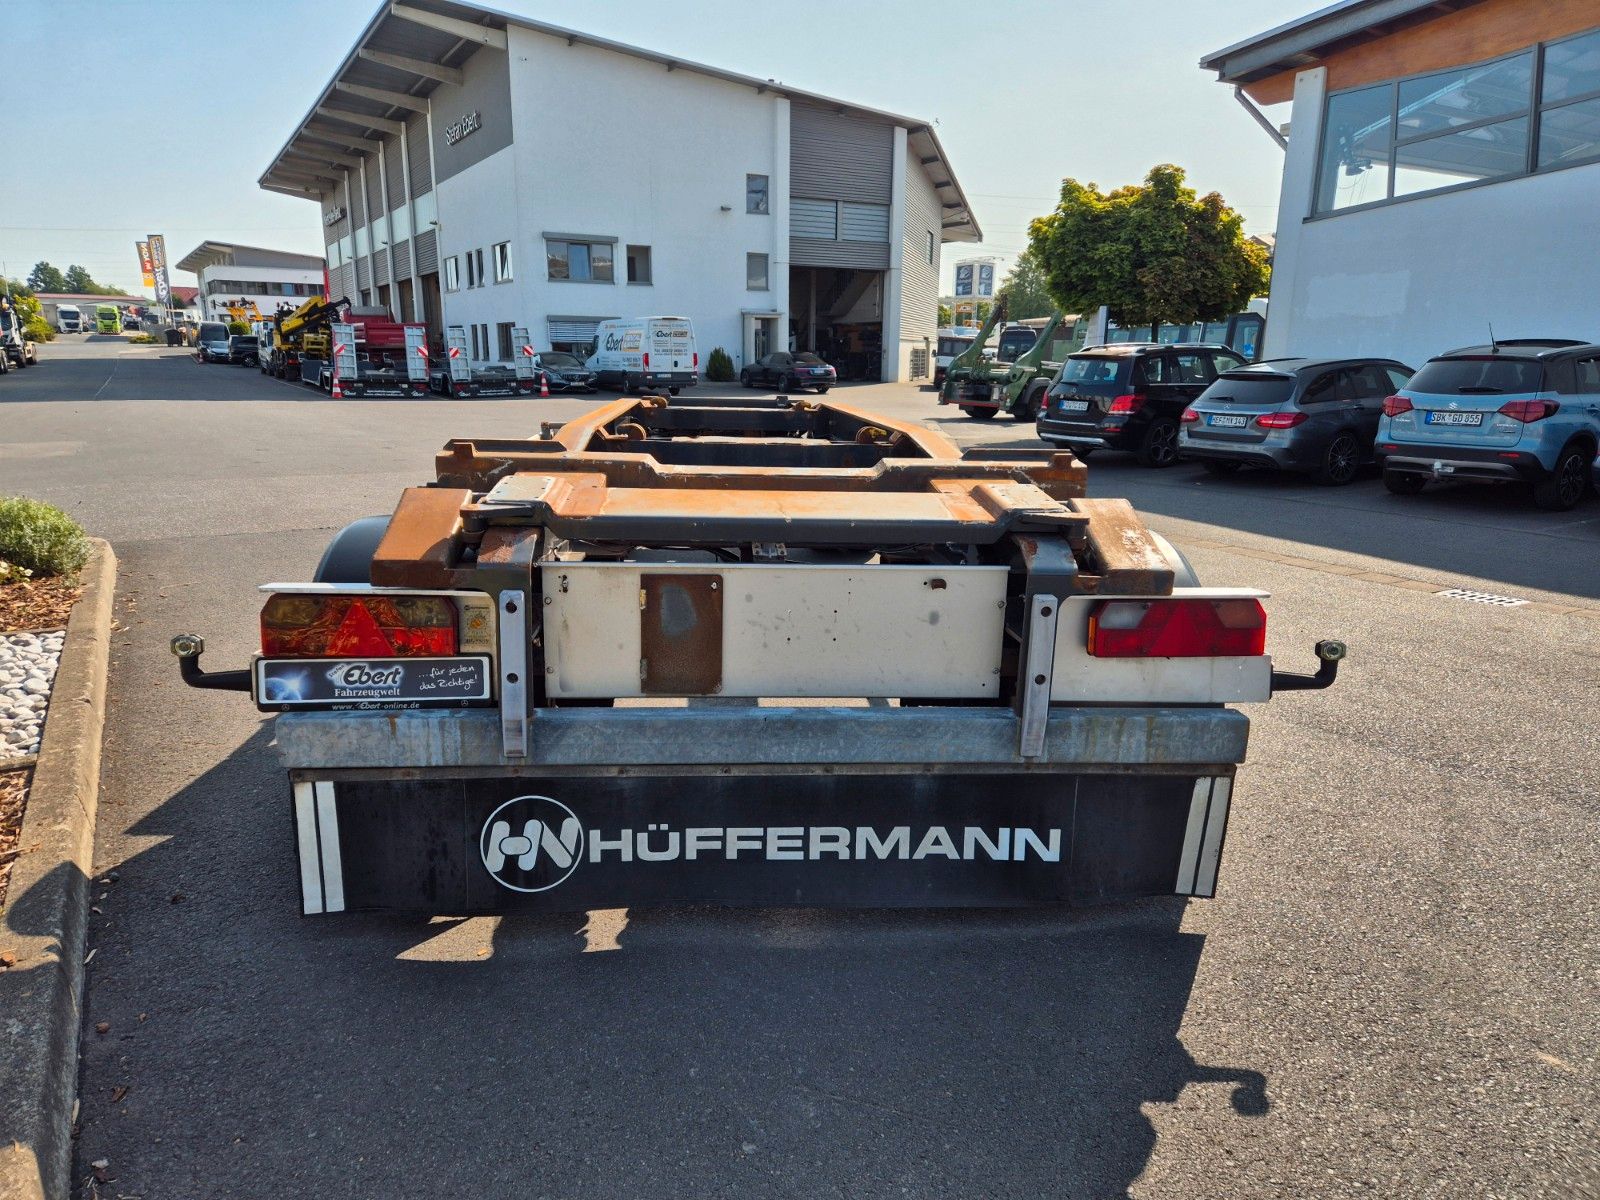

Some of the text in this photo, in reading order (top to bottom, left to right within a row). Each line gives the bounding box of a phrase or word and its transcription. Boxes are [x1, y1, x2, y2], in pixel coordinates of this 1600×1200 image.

[1431, 412, 1480, 424] SBK GD 855
[343, 664, 402, 686] Ebert
[448, 665, 475, 676] jeden
[419, 682, 436, 691] das
[334, 688, 400, 698] Fahrzeugwelt
[588, 823, 1062, 863] HÜFFERMANN
